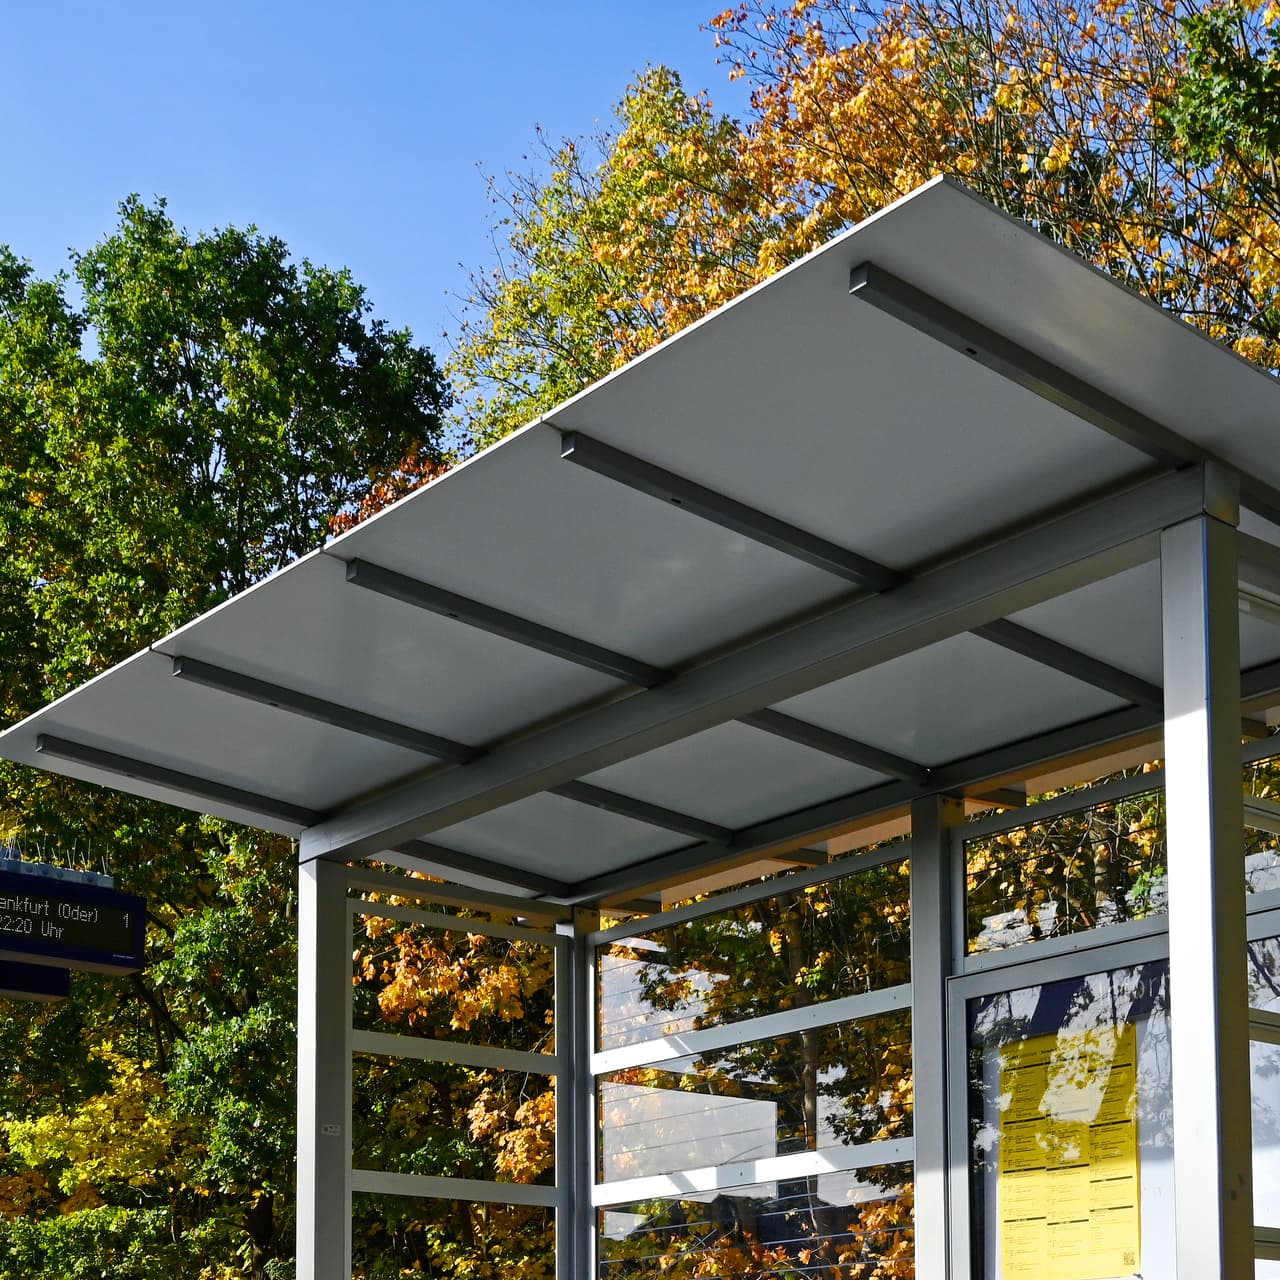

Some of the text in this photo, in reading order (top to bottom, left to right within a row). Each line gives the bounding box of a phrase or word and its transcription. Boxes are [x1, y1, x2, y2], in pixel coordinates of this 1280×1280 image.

[58, 902, 98, 924] (Oder)
[122, 912, 130, 929] 1
[41, 921, 64, 939] Uhr
